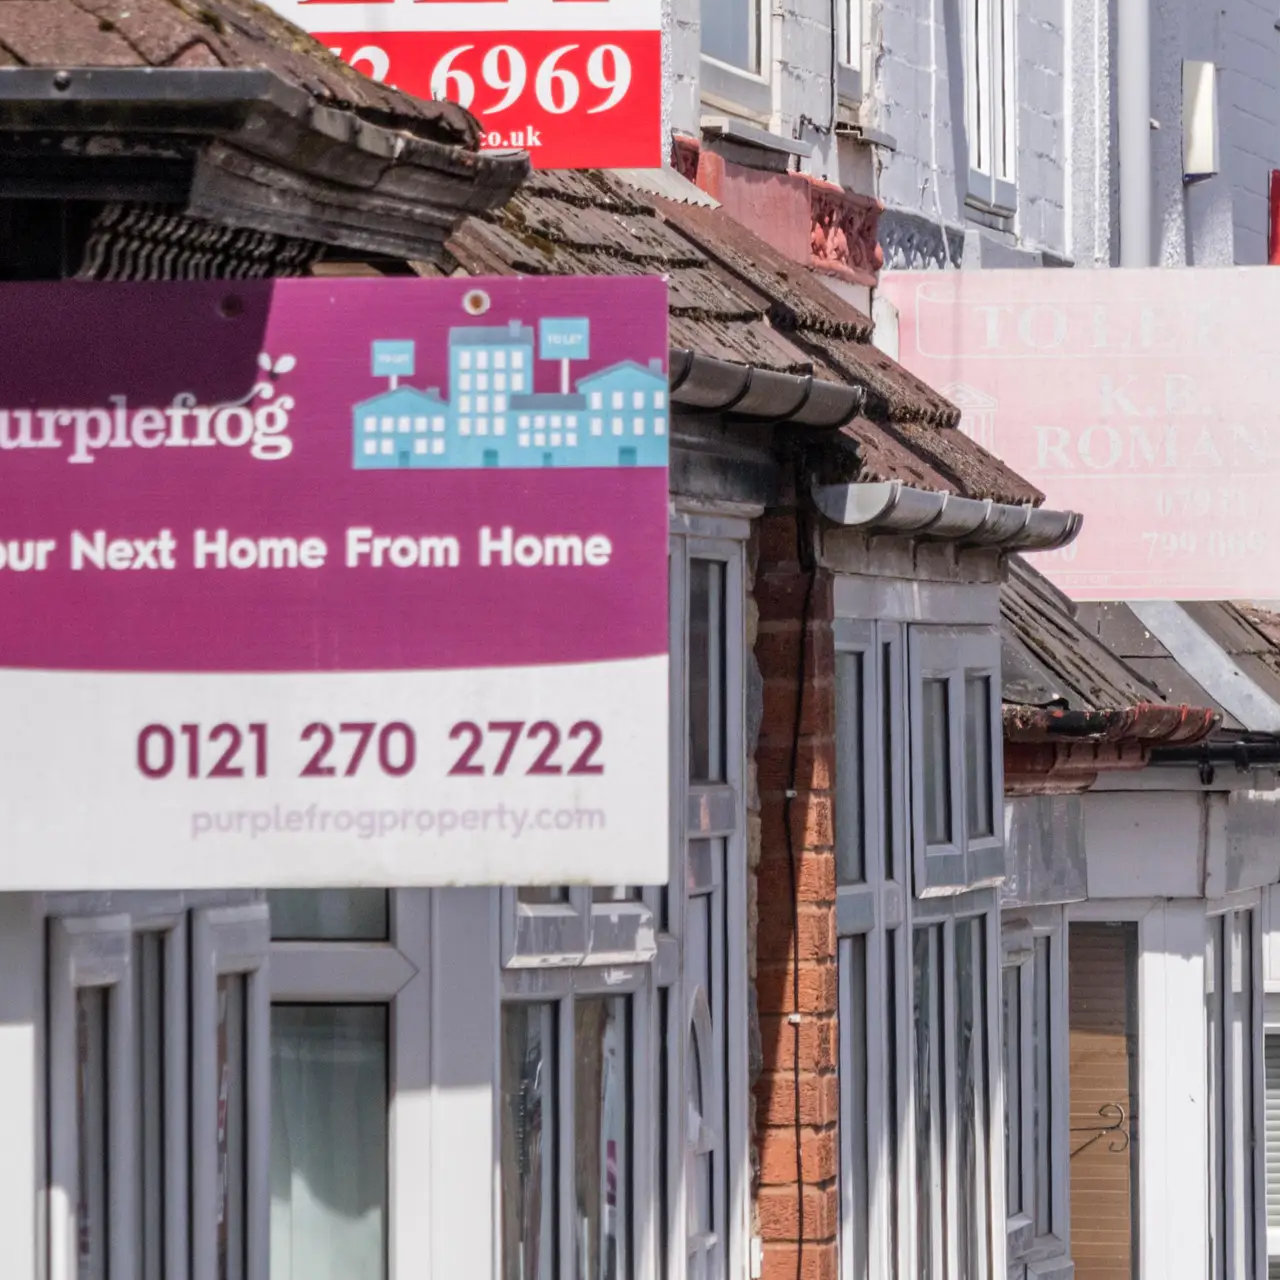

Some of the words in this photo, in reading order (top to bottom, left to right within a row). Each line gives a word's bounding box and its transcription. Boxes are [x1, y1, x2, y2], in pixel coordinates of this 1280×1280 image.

[430, 43, 633, 115] 6969
[973, 305, 1070, 349] TO
[1032, 424, 1272, 469] ROMAN
[71, 529, 176, 571] Next
[193, 527, 328, 570] Home
[346, 526, 460, 568] From
[478, 525, 613, 567] Home
[136, 723, 268, 779] 0121
[299, 722, 416, 778] 270
[448, 721, 604, 776] 2722
[190, 801, 606, 839] purplefrogproperty.com
